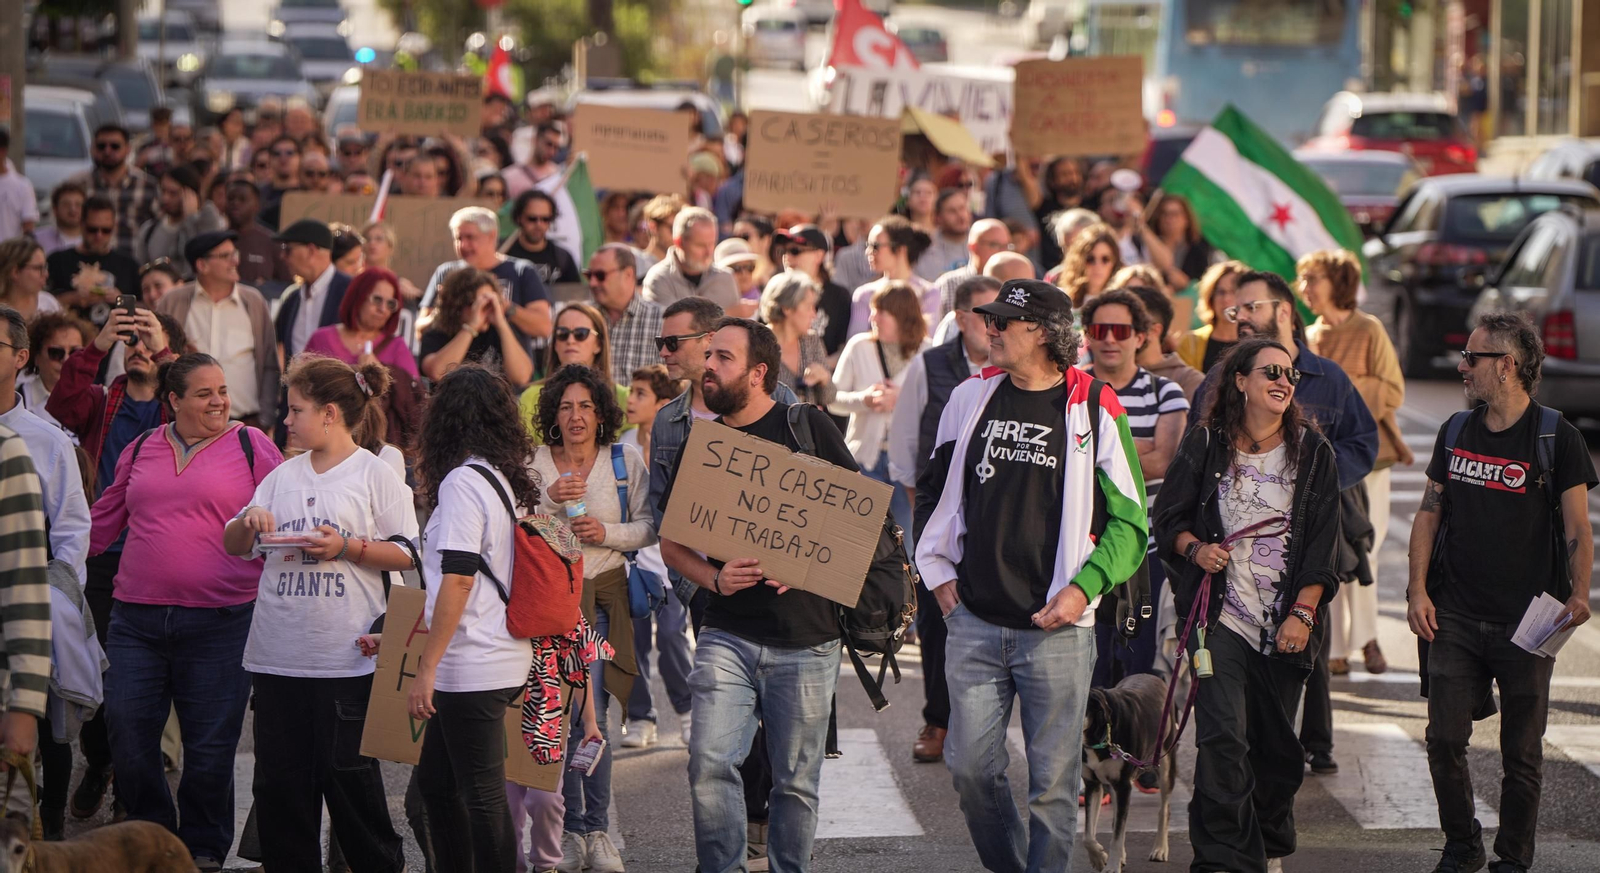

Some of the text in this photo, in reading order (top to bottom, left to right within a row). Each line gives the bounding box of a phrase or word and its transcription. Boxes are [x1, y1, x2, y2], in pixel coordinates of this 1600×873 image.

[365, 99, 468, 123] ERA BARRIO
[1028, 111, 1114, 136] CASERO
[760, 116, 898, 152] CASEROS
[981, 420, 1053, 446] JEREZ
[990, 445, 1057, 469] VIVIENDA
[703, 440, 874, 517] SER CASERO
[737, 490, 808, 528] NO ES
[275, 518, 306, 532] EW
[690, 502, 832, 564] UN TRABAJO
[277, 572, 345, 597] GIANTS
